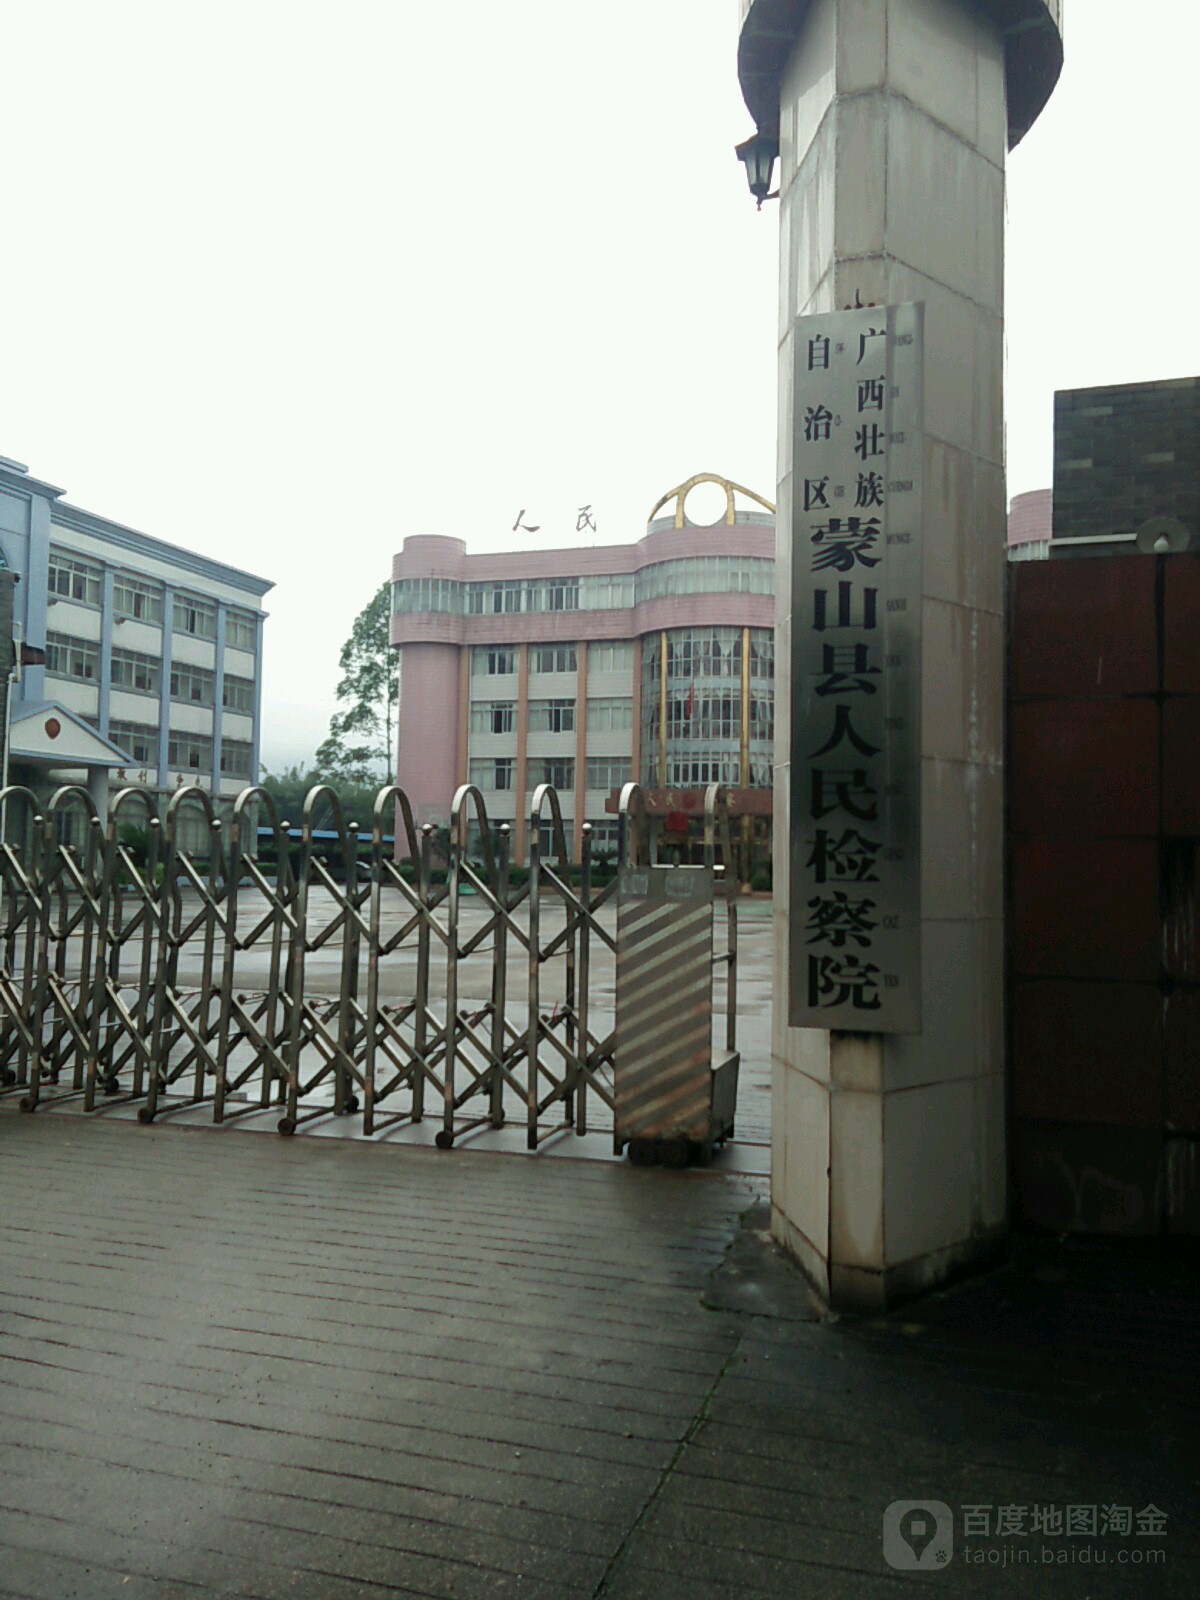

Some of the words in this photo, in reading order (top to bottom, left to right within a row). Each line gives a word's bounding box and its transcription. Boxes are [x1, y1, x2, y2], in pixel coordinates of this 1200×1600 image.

[803, 333, 833, 512] 自治区
[854, 327, 887, 508] 广西壮族
[512, 504, 597, 533] 人民
[805, 516, 883, 1010] 蒙山县人民检察院
